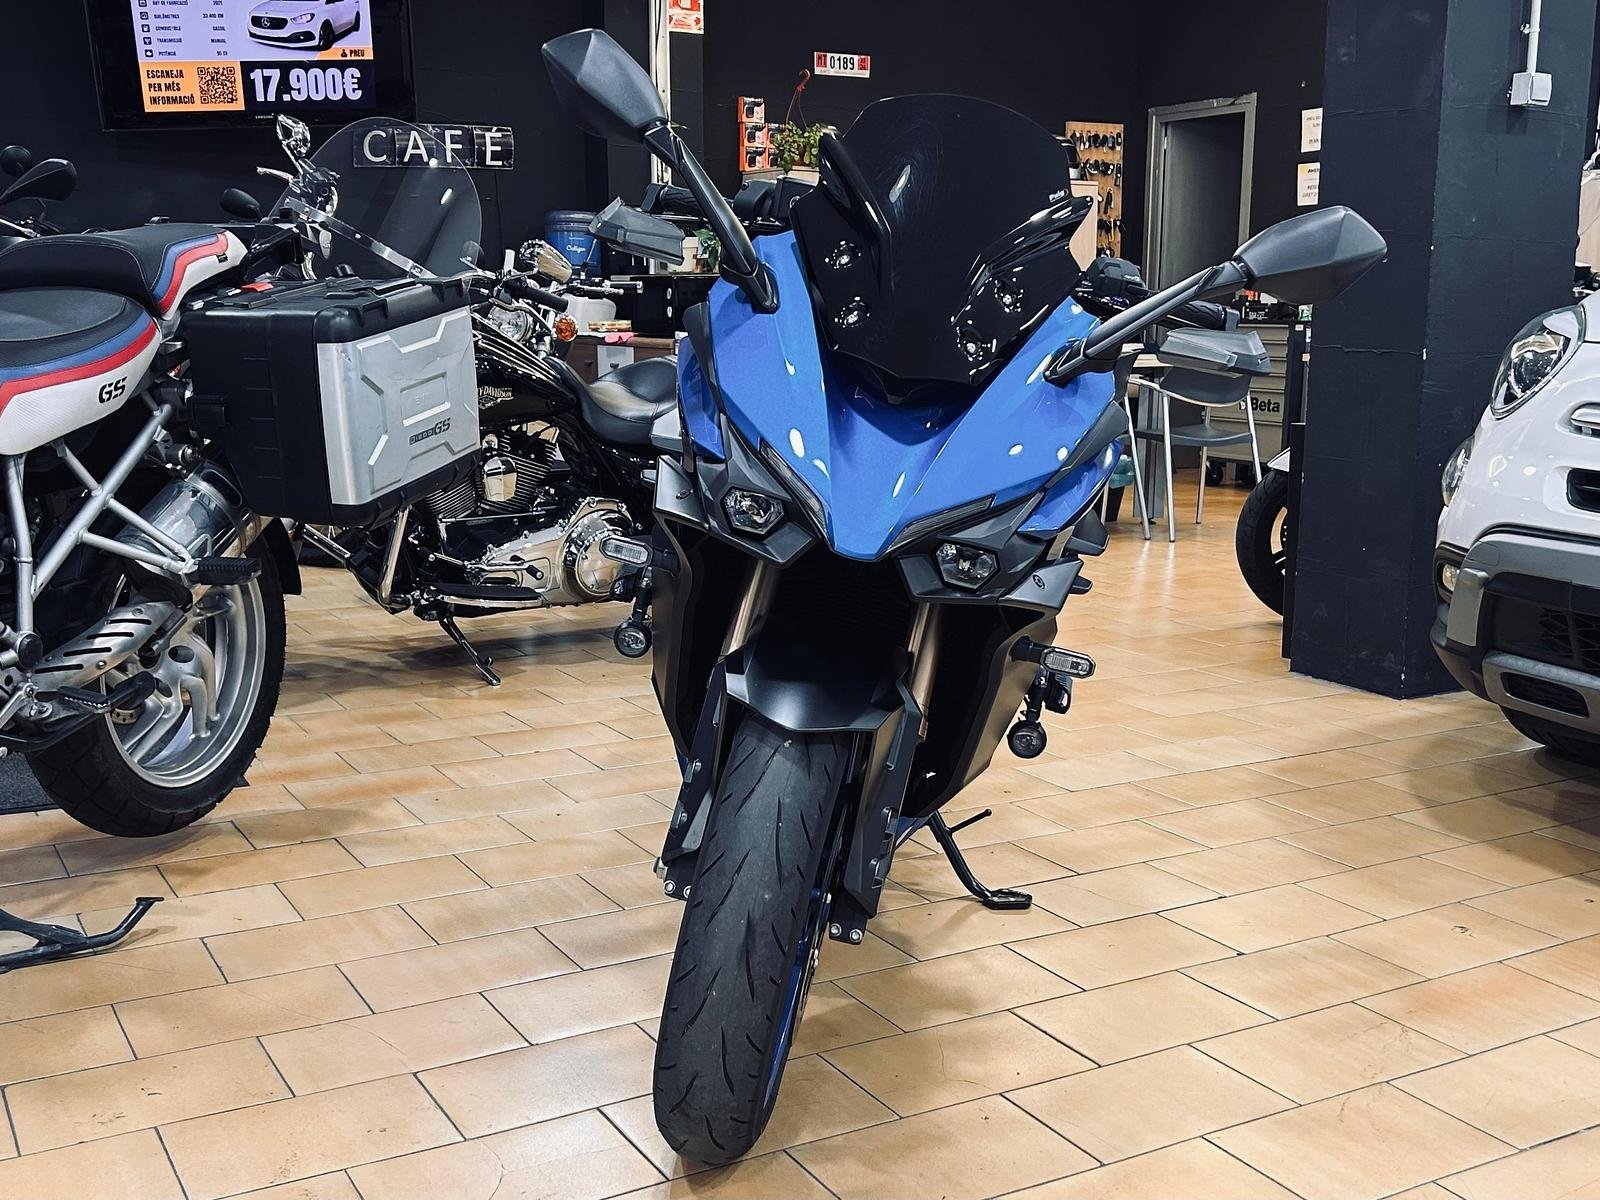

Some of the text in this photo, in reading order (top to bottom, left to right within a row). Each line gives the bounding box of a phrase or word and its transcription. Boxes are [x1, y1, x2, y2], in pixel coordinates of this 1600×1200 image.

[350, 48, 365, 58] PREU
[830, 55, 855, 71] 0189
[147, 69, 184, 79] ESCANEJA
[149, 81, 181, 92] PER MÉS
[250, 67, 363, 102] 17.900€
[150, 94, 195, 105] INFORMACIÓ
[363, 127, 503, 166] CAFÉ
[98, 376, 128, 404] GS
[1250, 397, 1280, 413] Beta
